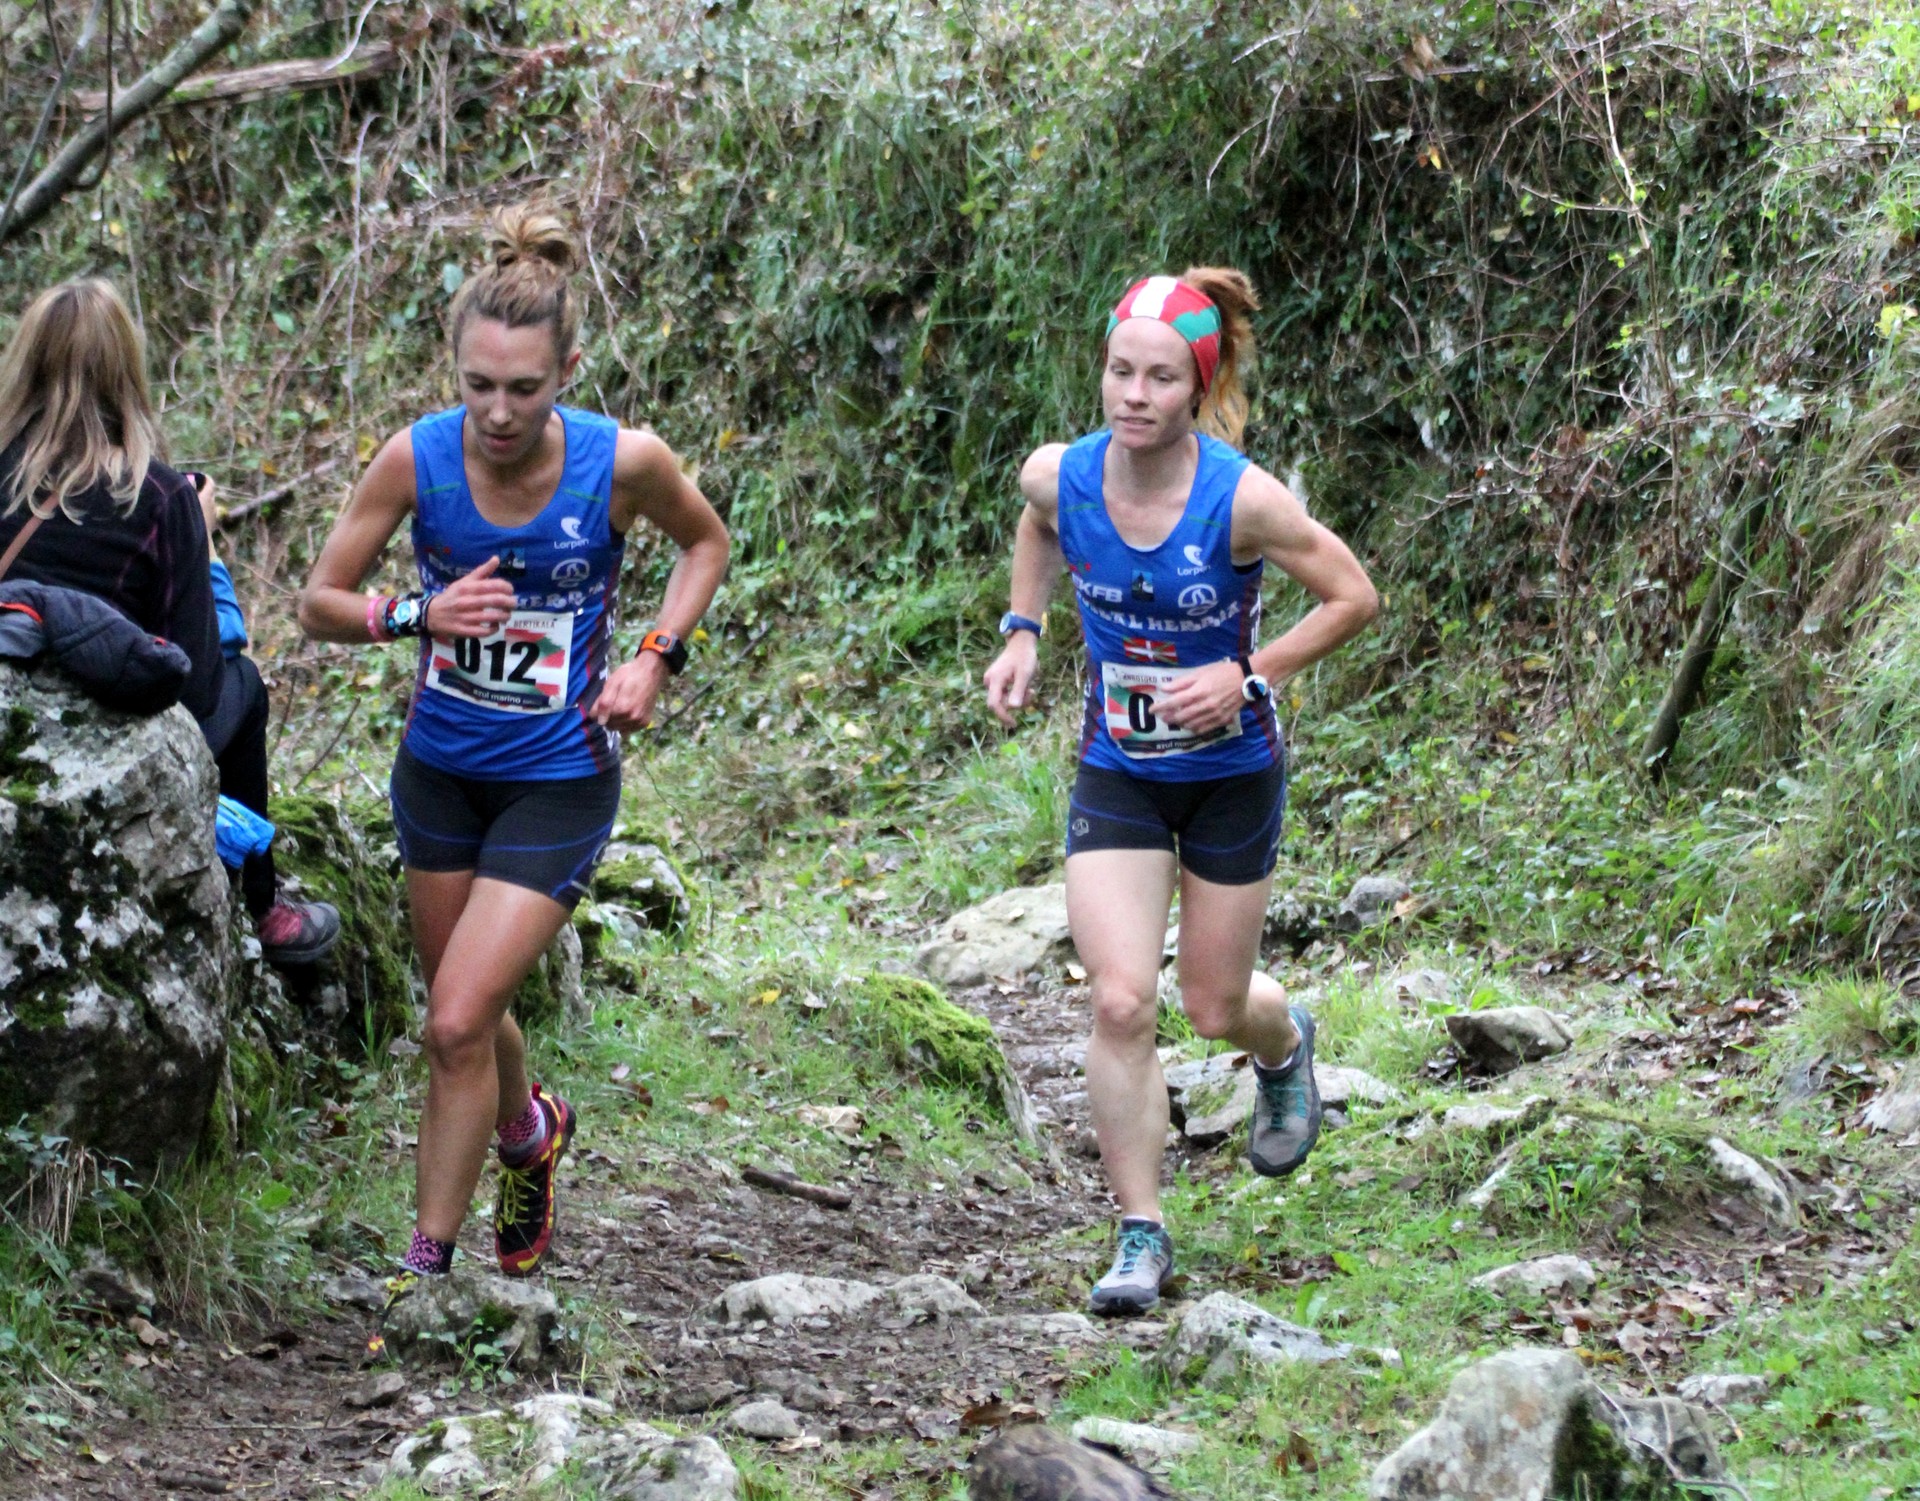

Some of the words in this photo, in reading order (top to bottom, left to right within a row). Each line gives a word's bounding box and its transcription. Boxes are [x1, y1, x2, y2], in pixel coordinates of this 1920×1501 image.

[553, 538, 589, 550] Lorpen
[455, 637, 540, 686] 012
[490, 694, 521, 704] marino
